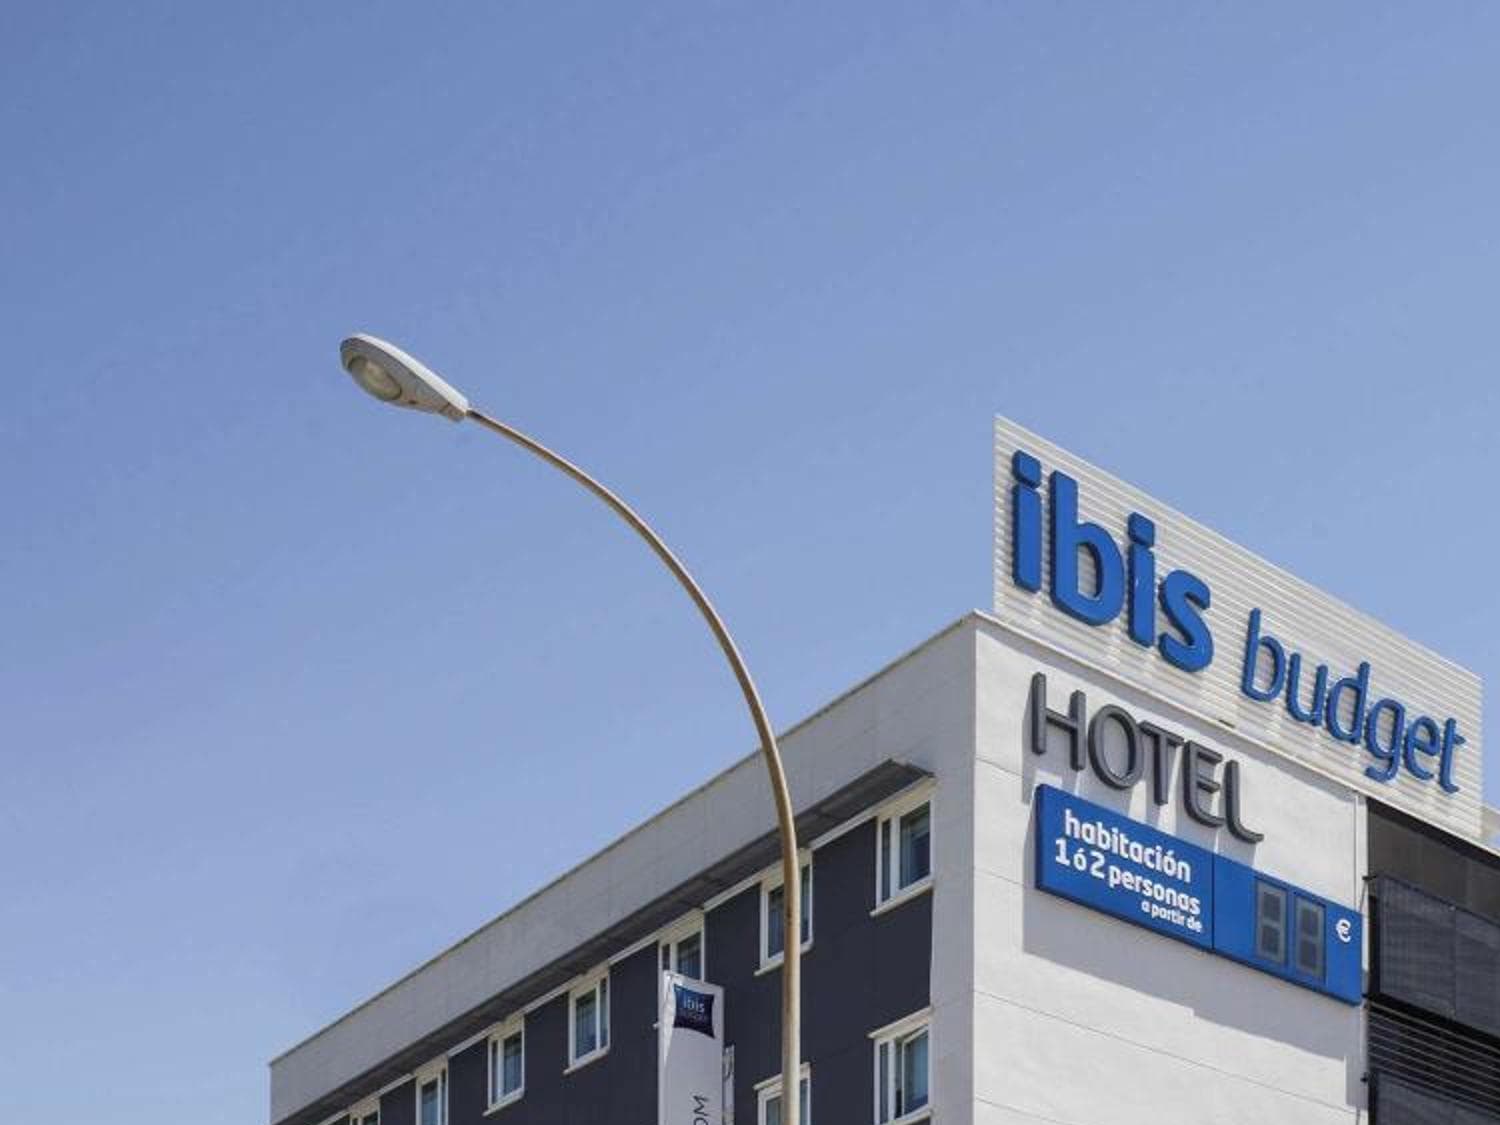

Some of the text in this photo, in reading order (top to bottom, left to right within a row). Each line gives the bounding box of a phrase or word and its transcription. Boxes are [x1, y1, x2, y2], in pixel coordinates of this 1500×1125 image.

[1012, 450, 1466, 793] ibis budget
[1031, 671, 1265, 844] HOTEL
[1055, 838, 1071, 867] 1
[1089, 850, 1106, 879] 2
[1108, 864, 1201, 915] personas
[1064, 808, 1192, 883] habitación
[1141, 901, 1203, 932] a partir de
[1336, 918, 1352, 943] €
